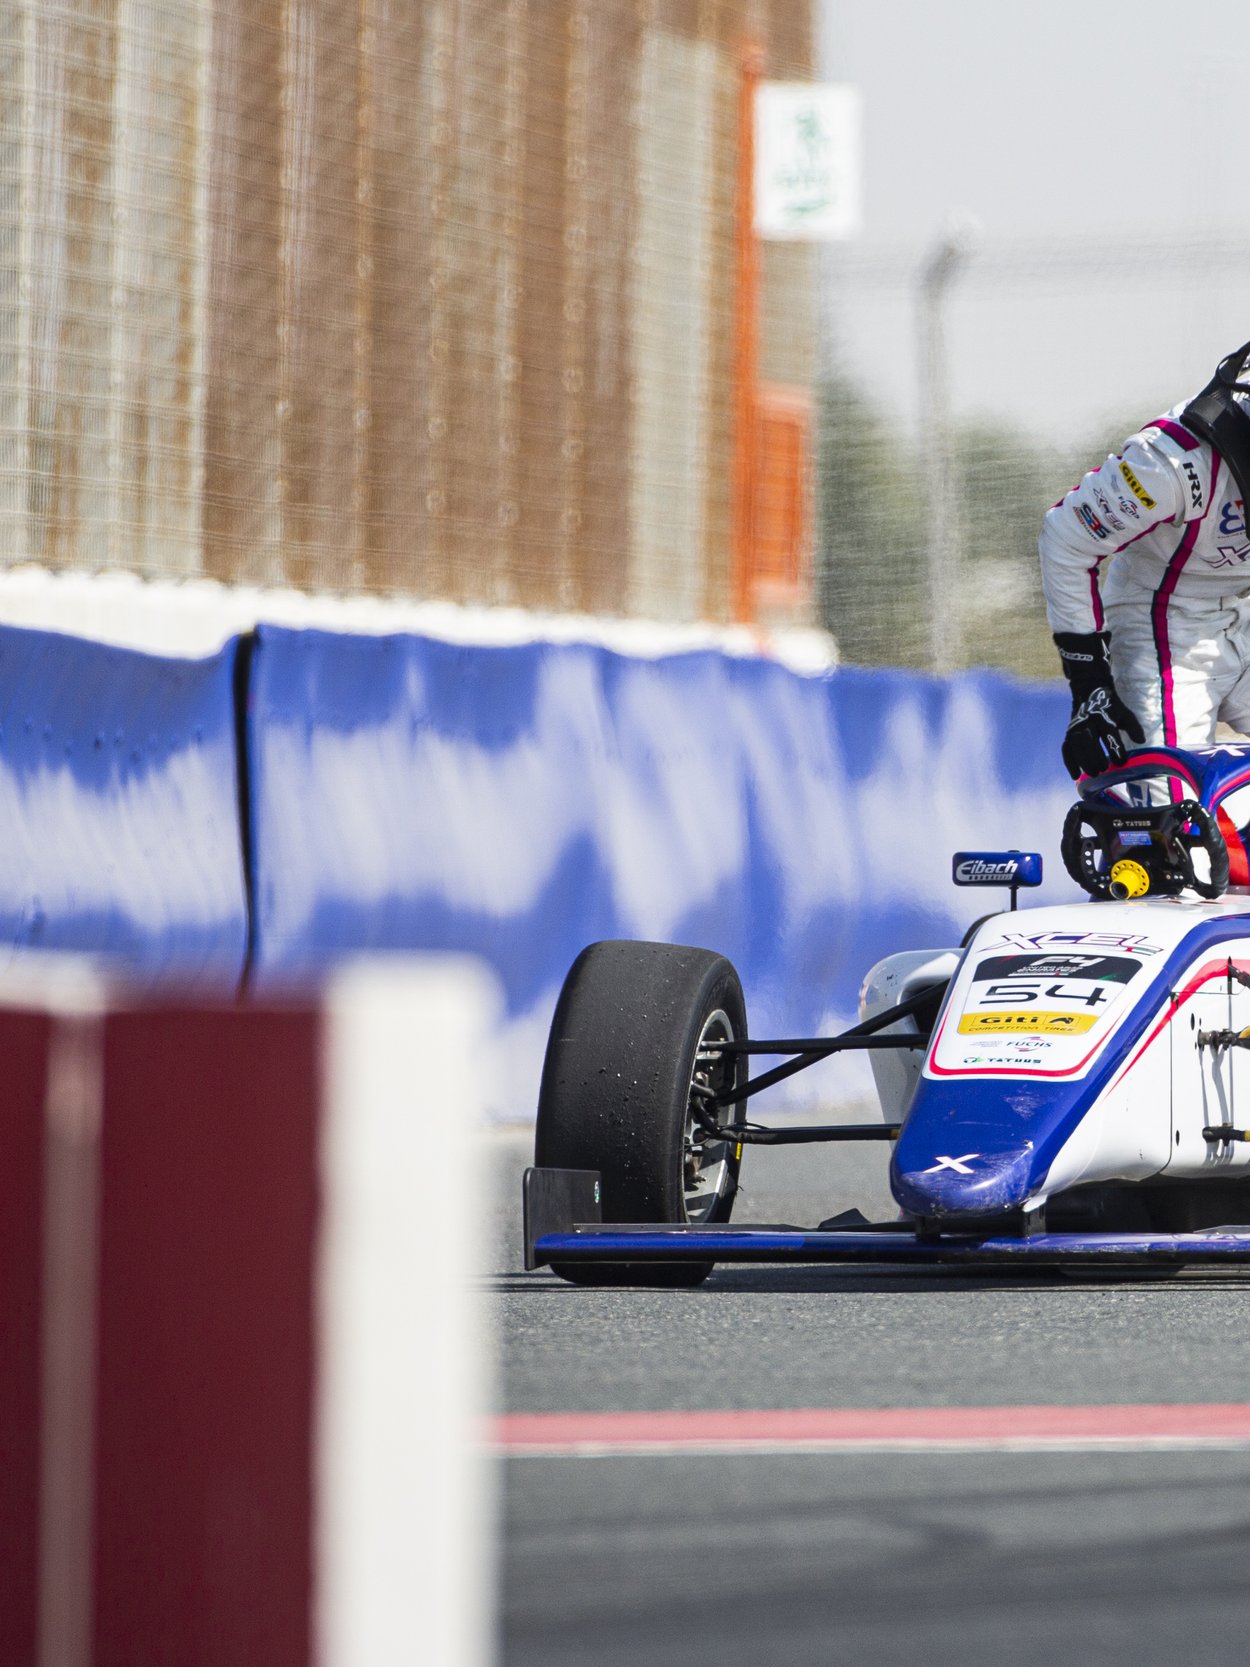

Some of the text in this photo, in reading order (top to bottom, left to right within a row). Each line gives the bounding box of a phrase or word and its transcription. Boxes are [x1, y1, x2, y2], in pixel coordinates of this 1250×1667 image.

[1183, 462, 1203, 509] HRX
[955, 860, 1018, 881] Eibach
[978, 931, 1164, 955] XCEL
[1029, 955, 1106, 967] F4
[979, 983, 1107, 1006] 54
[980, 1016, 1039, 1024] Giti
